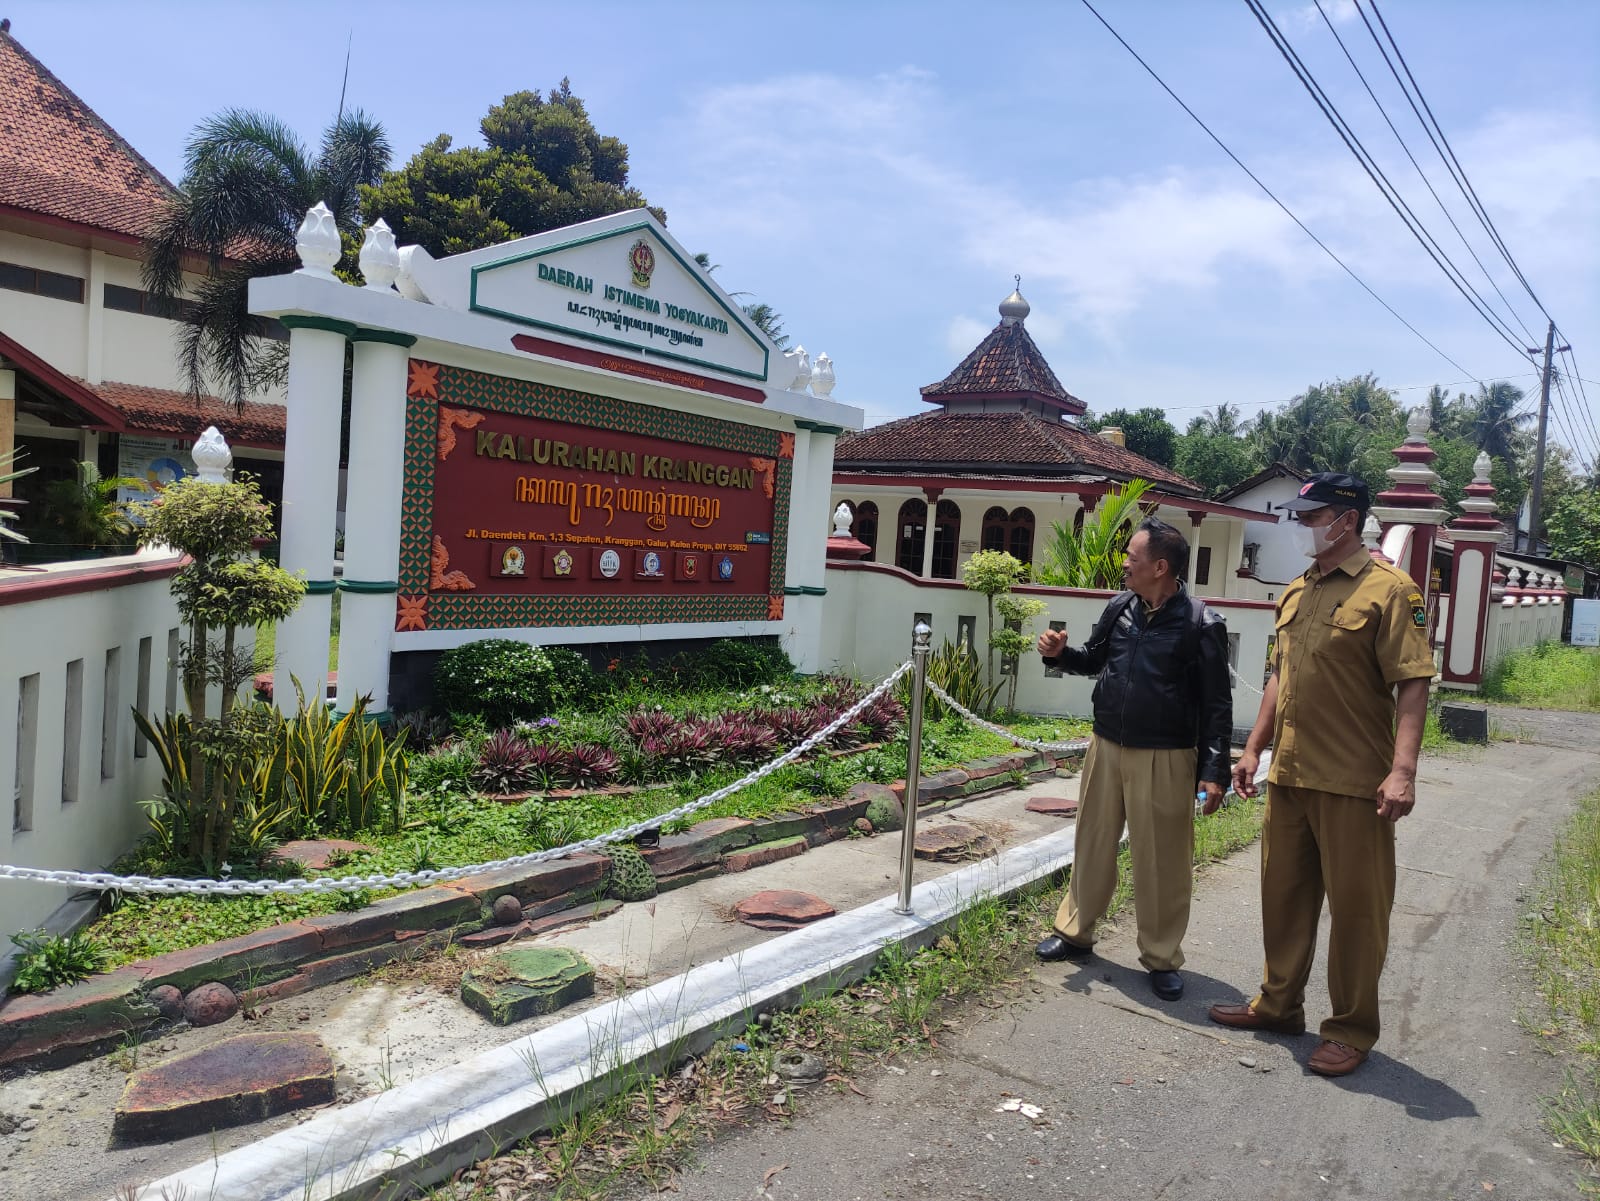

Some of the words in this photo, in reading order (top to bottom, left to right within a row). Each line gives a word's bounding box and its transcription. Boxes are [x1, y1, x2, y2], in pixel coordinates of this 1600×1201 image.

[537, 263, 593, 294] DAERAH
[604, 284, 661, 315] ISTIMEWA
[664, 302, 729, 335] YOGYAKARTA
[476, 430, 636, 476] KALURAHAN
[642, 455, 755, 489] KRANGGAN
[465, 529, 478, 538] Jl.
[481, 529, 526, 540] Daendels
[549, 532, 564, 542] 1,3
[604, 535, 645, 548] Kranggan,
